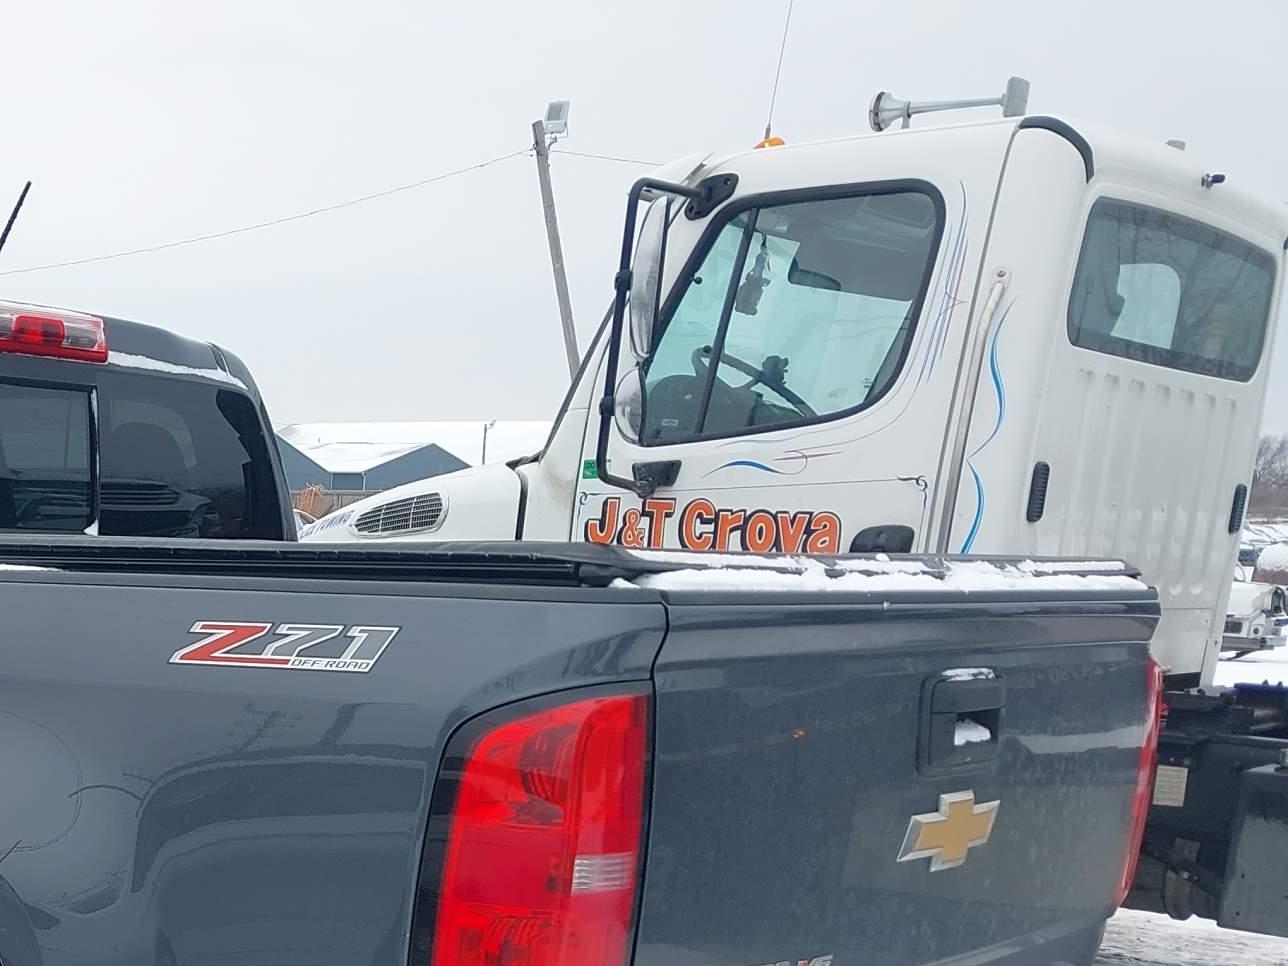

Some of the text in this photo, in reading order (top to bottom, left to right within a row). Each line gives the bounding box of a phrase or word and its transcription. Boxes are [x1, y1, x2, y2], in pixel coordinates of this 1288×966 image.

[584, 497, 843, 553] J&T Crova
[167, 620, 402, 673] Z71
[290, 658, 371, 671] OFF ROAD
